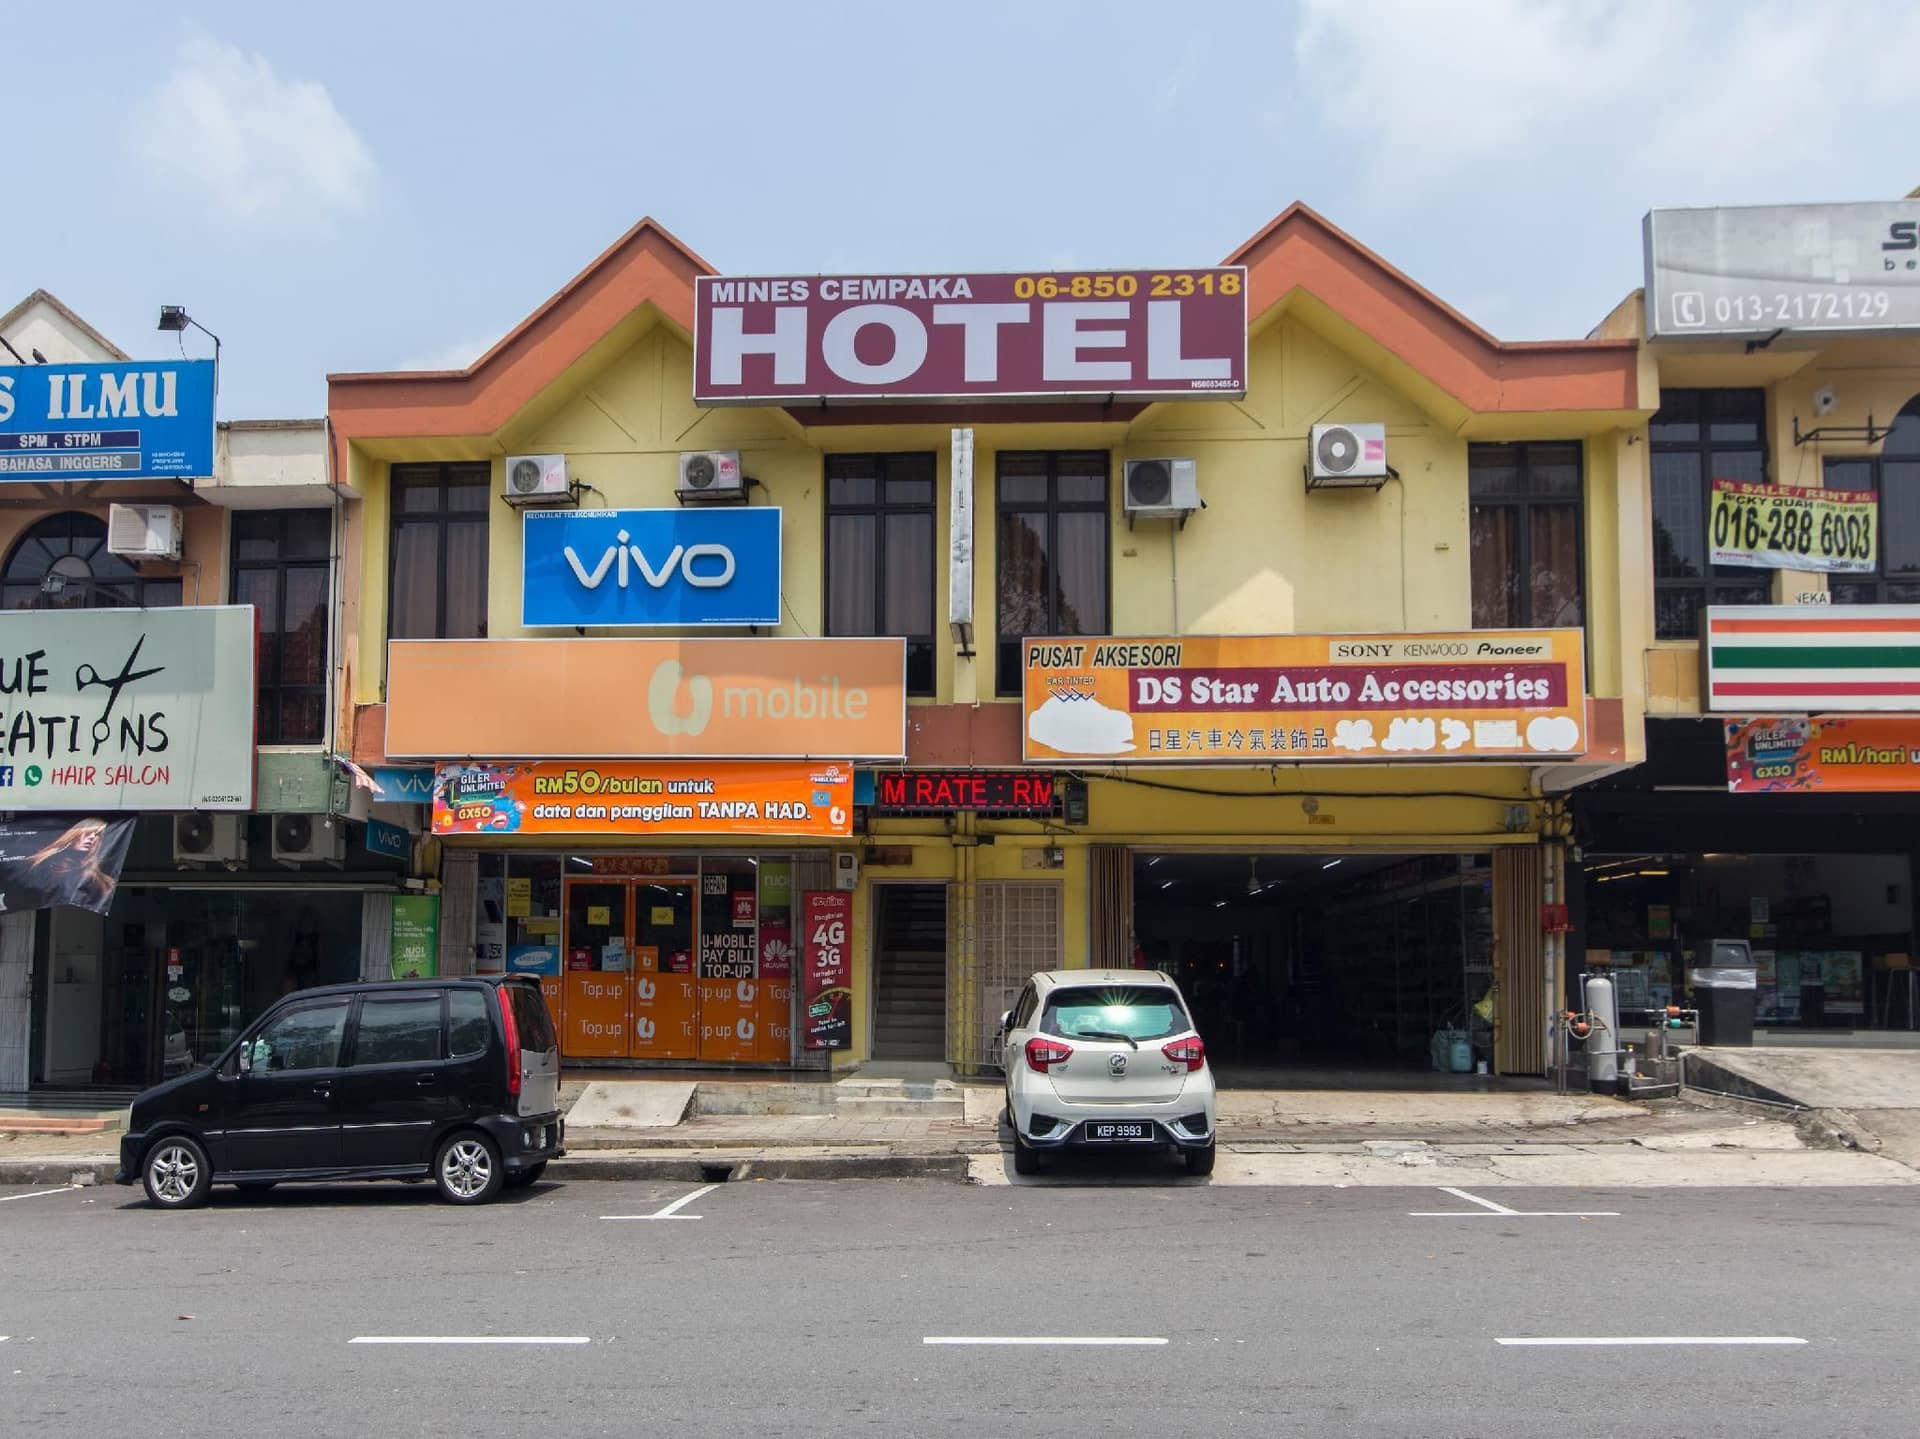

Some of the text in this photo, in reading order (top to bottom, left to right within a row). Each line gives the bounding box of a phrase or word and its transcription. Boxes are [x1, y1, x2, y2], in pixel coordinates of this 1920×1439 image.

[1881, 221, 1920, 250] S
[711, 278, 973, 303] MINES CEMPAKA
[1014, 273, 1241, 299] 06-850 2318
[1715, 292, 1889, 322] 013-2172129
[709, 300, 1232, 385] HOTEL
[48, 371, 178, 420] ILMU
[20, 434, 48, 448] SPM
[64, 432, 101, 447] STPM
[1, 455, 122, 472] BAHASA INGGERIS
[1714, 502, 1871, 560] 016-288 6003
[564, 528, 736, 589] vivo
[1028, 644, 1181, 668] PUSAT AKSESORI
[1338, 642, 1543, 657] SONY KENWOOD Pioneer
[1137, 672, 1549, 705] DS Star Auto Accessories
[723, 679, 869, 720] mobile
[1755, 731, 1787, 742] GILER
[1755, 738, 1805, 751] UNLIMITED
[1820, 743, 1906, 764] RM1/hari
[51, 765, 169, 785] HAIR SALON
[461, 773, 490, 784] GILER
[535, 770, 715, 794] RM50/bulan untuk
[460, 781, 506, 792] UNLIMITED
[884, 779, 906, 803] M
[915, 779, 987, 803] RATE
[1013, 779, 1052, 803] RM
[533, 801, 812, 821] data dan panggilan TANPA HAD.
[702, 935, 756, 948] U-MOBILE
[812, 921, 845, 946] 4G
[702, 950, 725, 962] PAY
[728, 950, 754, 963] BILL
[817, 948, 840, 967] 3G
[705, 965, 751, 978] TOP-UP
[581, 981, 623, 999] Top up
[716, 987, 732, 1001] up
[768, 985, 791, 1003] Top
[581, 1020, 622, 1037] Top up
[716, 1025, 732, 1040] up
[768, 1023, 791, 1042] Top
[1097, 1125, 1115, 1136] KEP
